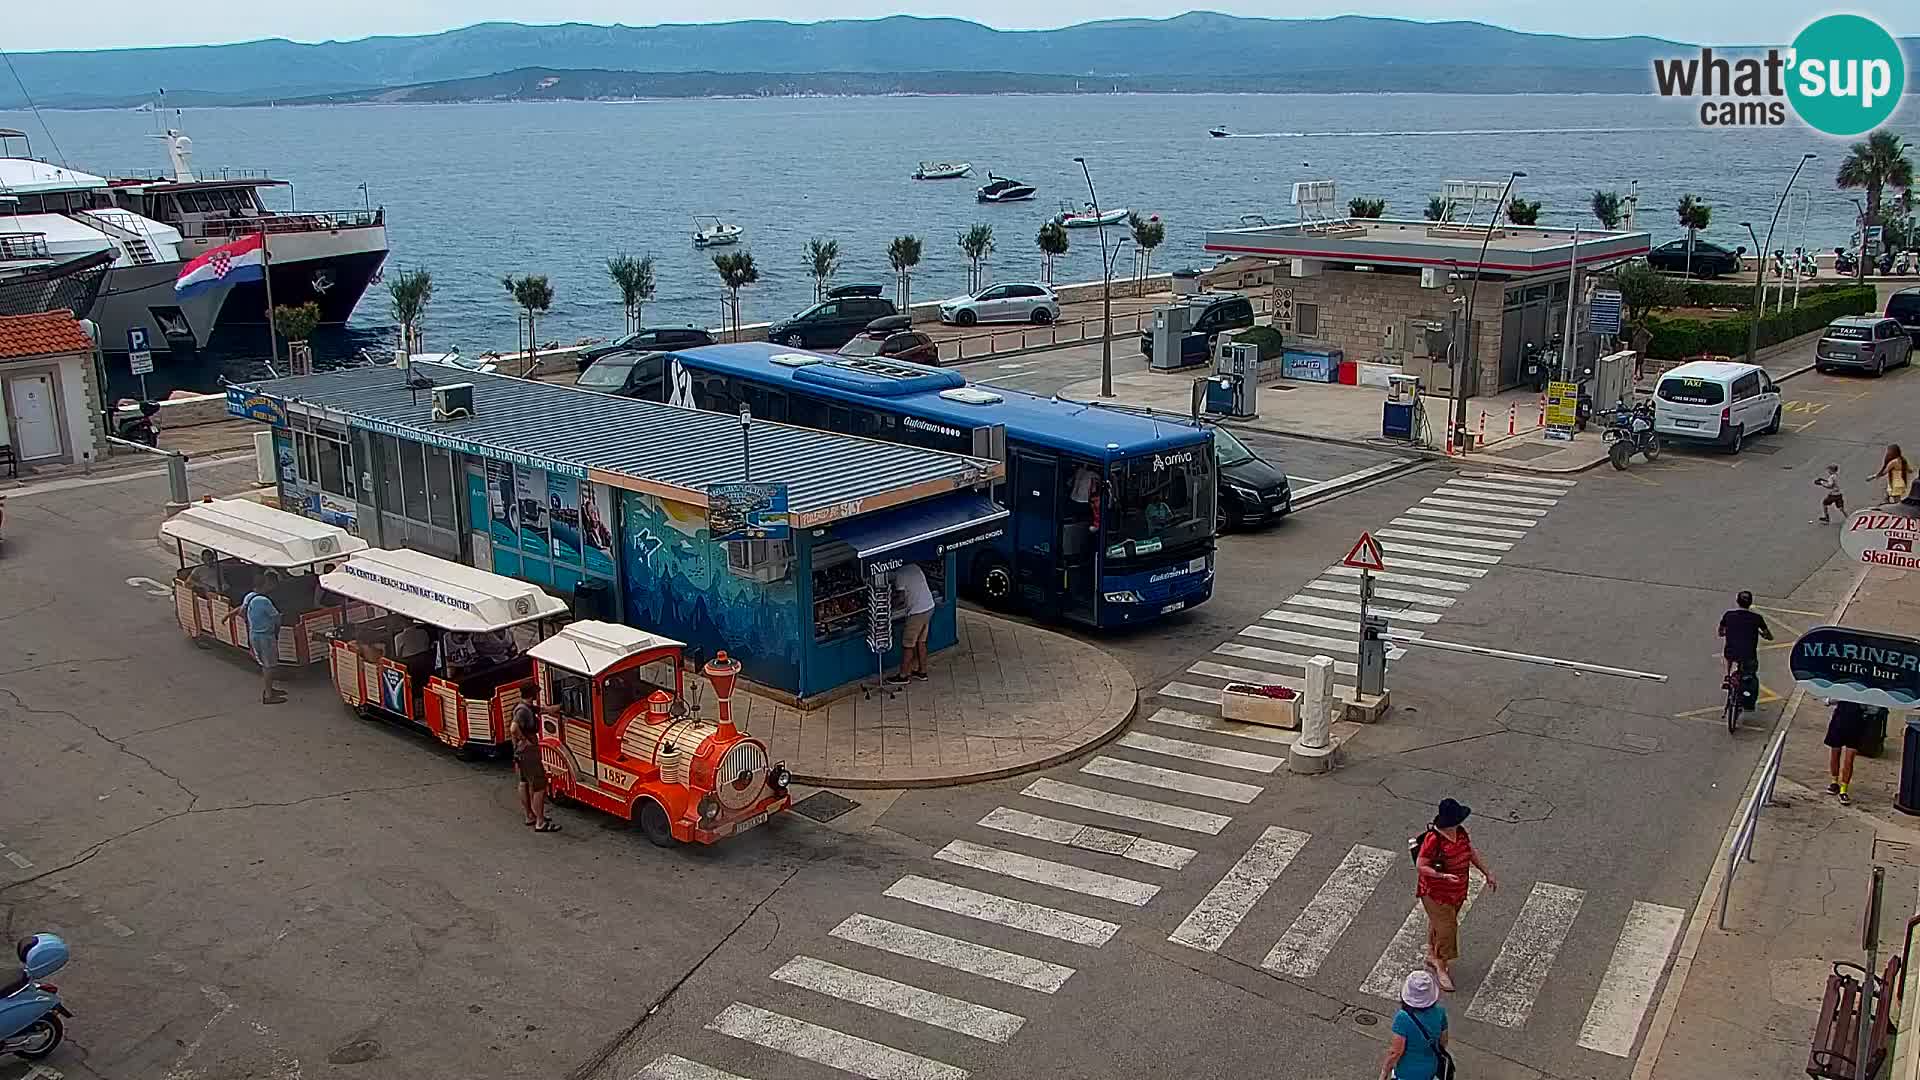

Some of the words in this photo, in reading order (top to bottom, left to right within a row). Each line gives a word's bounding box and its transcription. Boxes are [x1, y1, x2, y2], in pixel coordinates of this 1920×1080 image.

[131, 331, 144, 349] P
[397, 425, 437, 445] AUTOBUSNA
[438, 434, 469, 452] POSTAJA
[480, 447, 495, 458] BUS
[495, 450, 528, 466] STATION
[529, 457, 555, 472] TICKET
[557, 464, 584, 477] OFFICE
[1165, 451, 1192, 466] arriva
[1850, 514, 1920, 533] PIZZE
[1884, 531, 1919, 541] GRILL
[345, 565, 356, 576] BOL
[356, 568, 377, 583] CENTER
[381, 576, 398, 589] BEACH
[399, 581, 418, 596] ZLATNI
[420, 588, 431, 599] RAT
[434, 592, 447, 604] BOL
[447, 596, 470, 612] CENTER
[1803, 642, 1920, 673] MARINER
[1831, 662, 1868, 675] caffe
[1872, 665, 1900, 681] bar
